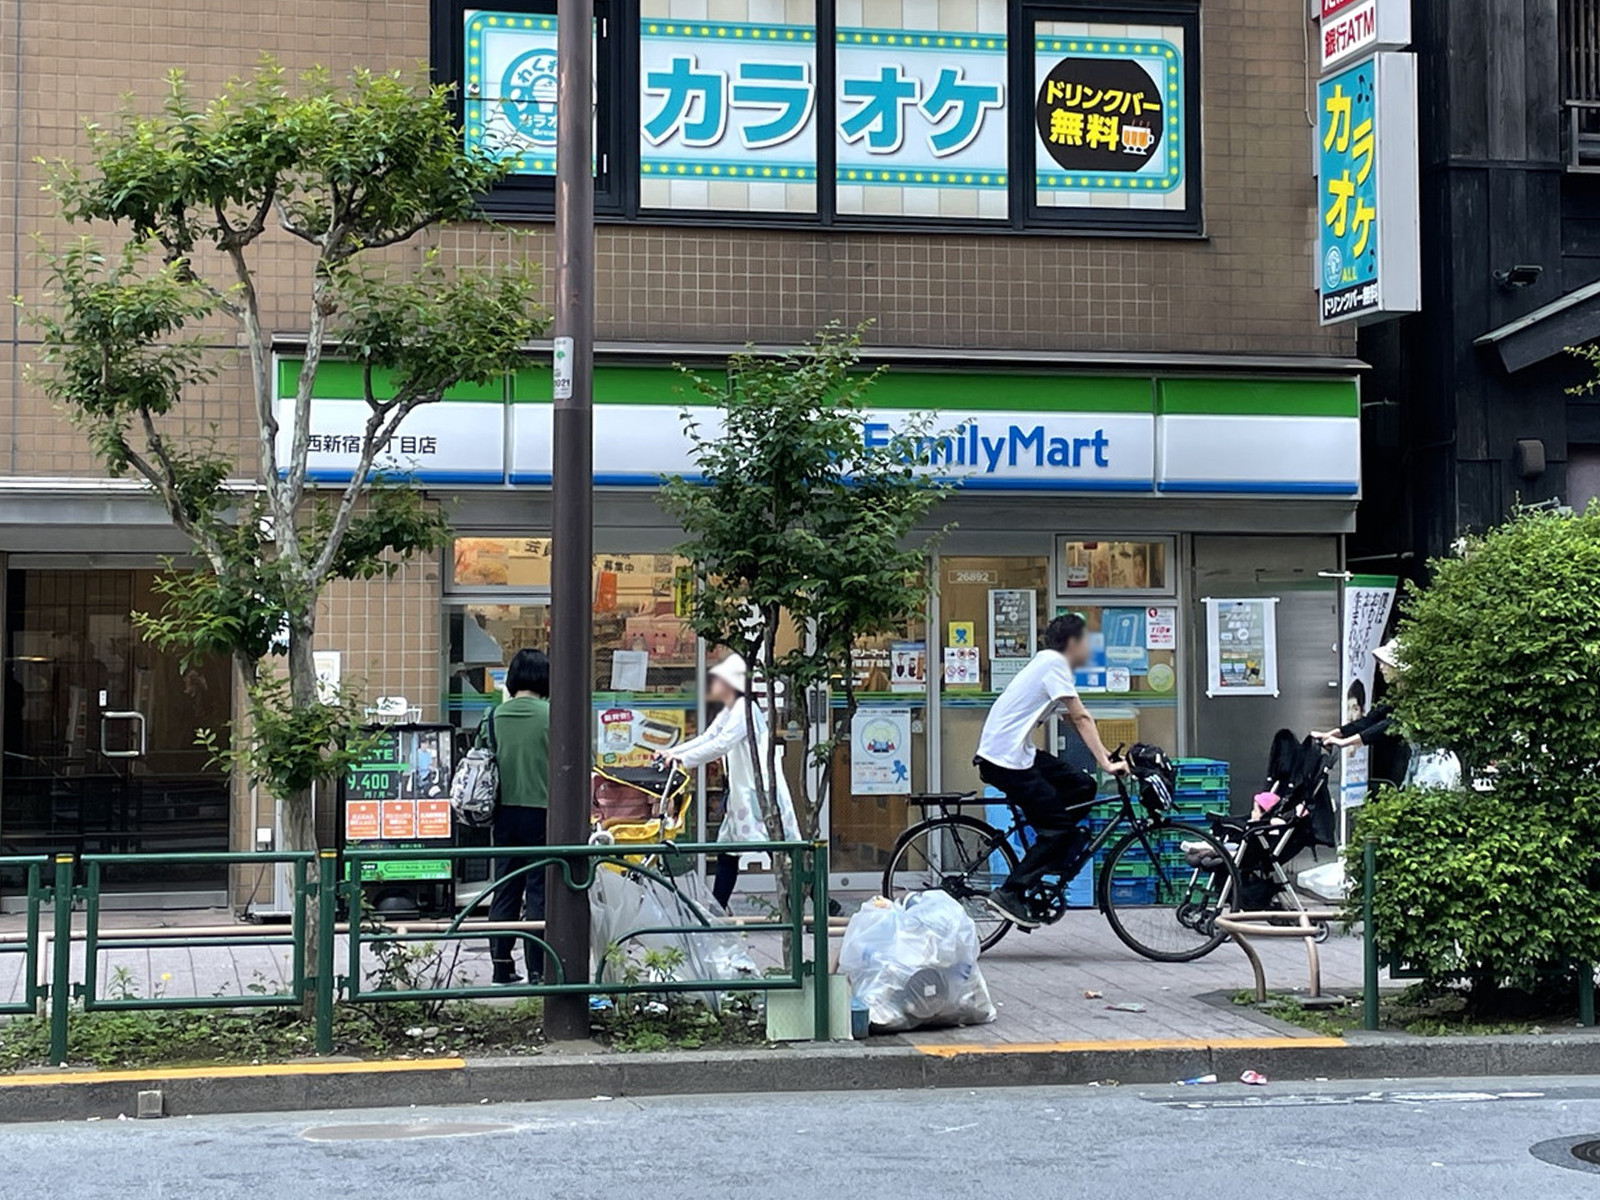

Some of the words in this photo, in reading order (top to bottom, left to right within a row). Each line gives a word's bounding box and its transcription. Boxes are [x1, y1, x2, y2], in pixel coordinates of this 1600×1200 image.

[1325, 6, 1374, 58] 銀行ATM
[642, 57, 999, 152] カラオケ
[1046, 80, 1161, 116] ドリンクバー
[1049, 108, 1120, 151] 無料
[1323, 84, 1375, 259] カラオケ
[307, 434, 438, 455] 西新宿丁目店
